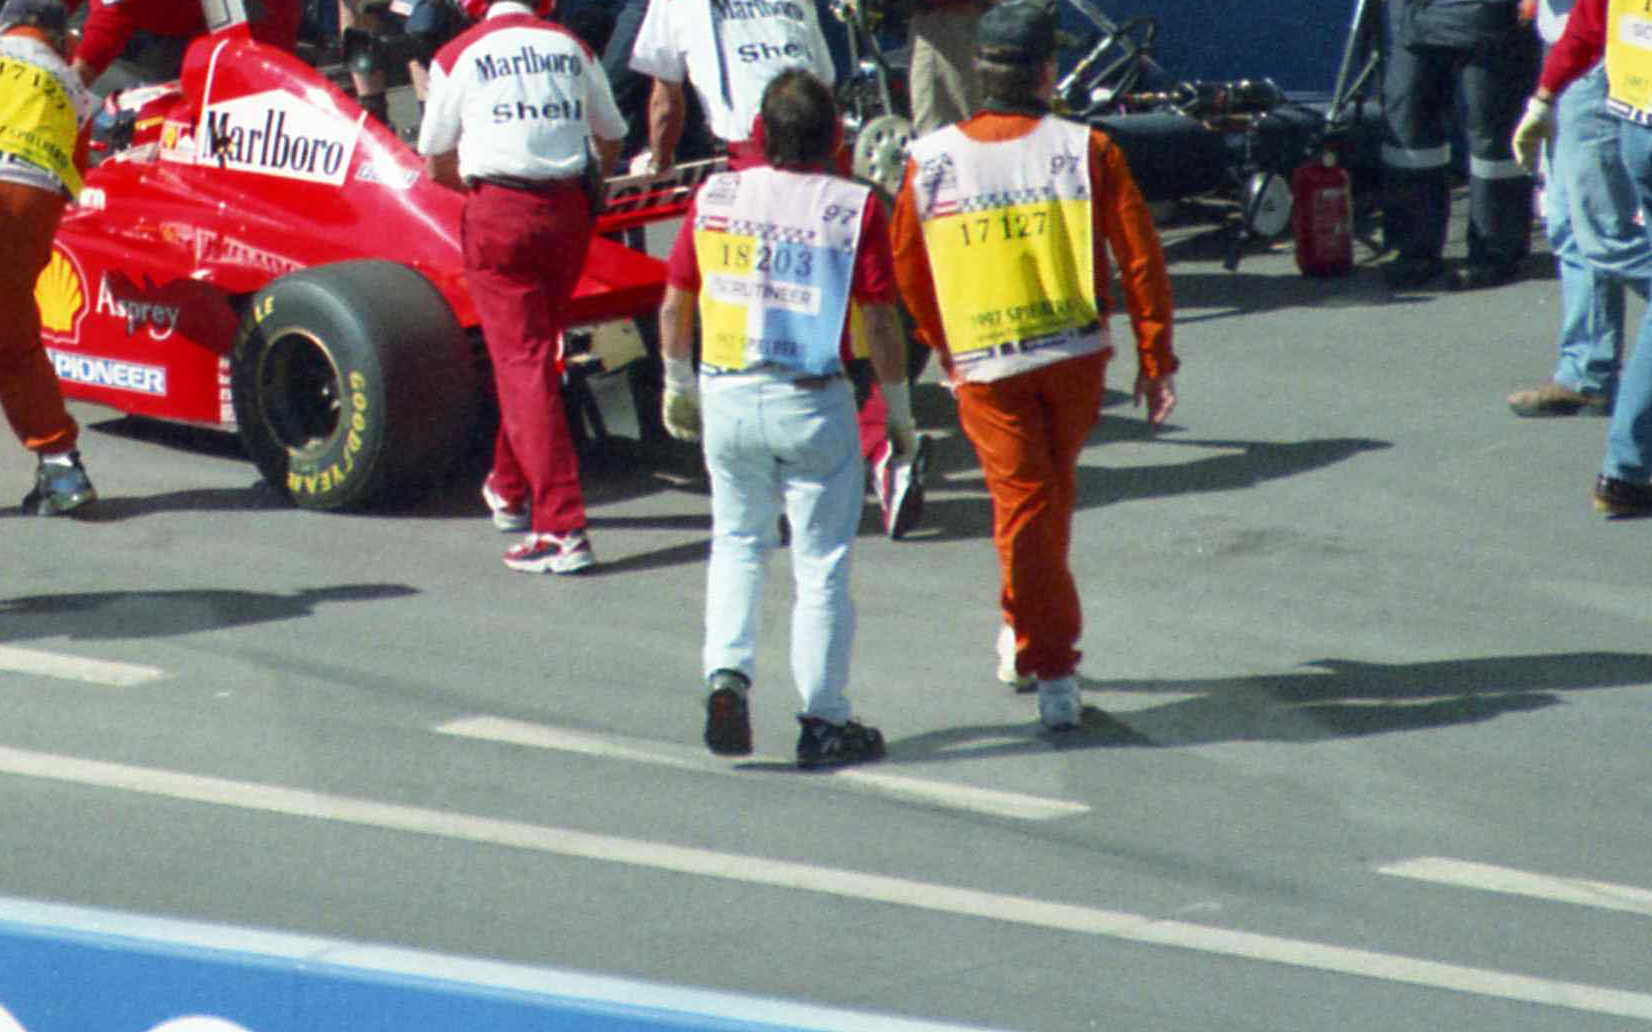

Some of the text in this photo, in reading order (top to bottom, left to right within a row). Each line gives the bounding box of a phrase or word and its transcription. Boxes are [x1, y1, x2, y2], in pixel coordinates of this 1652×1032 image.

[475, 46, 582, 81] Marlboro
[492, 99, 582, 124] Shell
[203, 110, 344, 176] Marlboro
[823, 203, 858, 225] 97
[96, 270, 180, 341] Asprey
[54, 352, 166, 394] PIONEER
